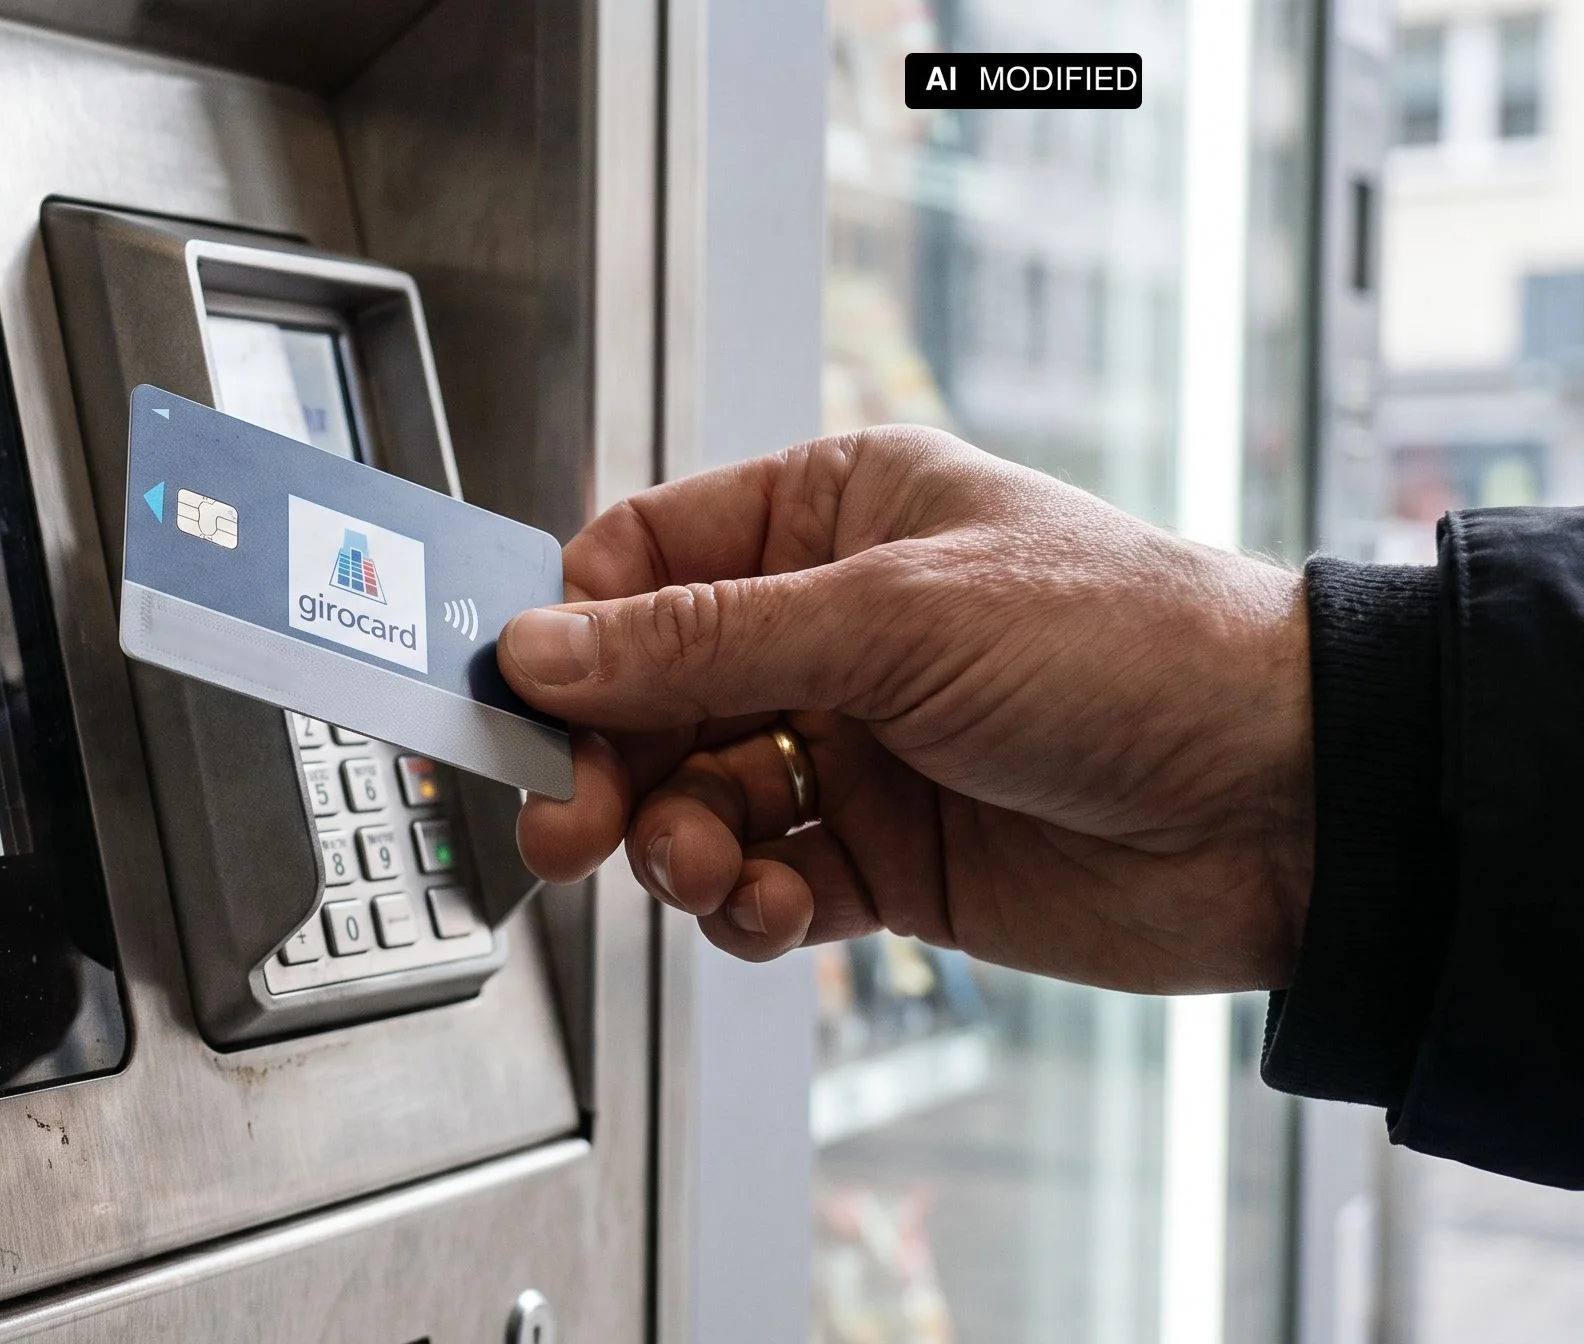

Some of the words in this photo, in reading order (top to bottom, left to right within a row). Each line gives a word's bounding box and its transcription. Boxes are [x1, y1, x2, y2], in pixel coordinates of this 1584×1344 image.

[298, 593, 417, 651] girocard
[315, 783, 329, 806] 5
[365, 780, 376, 801] 6
[332, 852, 345, 876] 8
[379, 846, 392, 869] 9
[346, 915, 360, 942] 0
